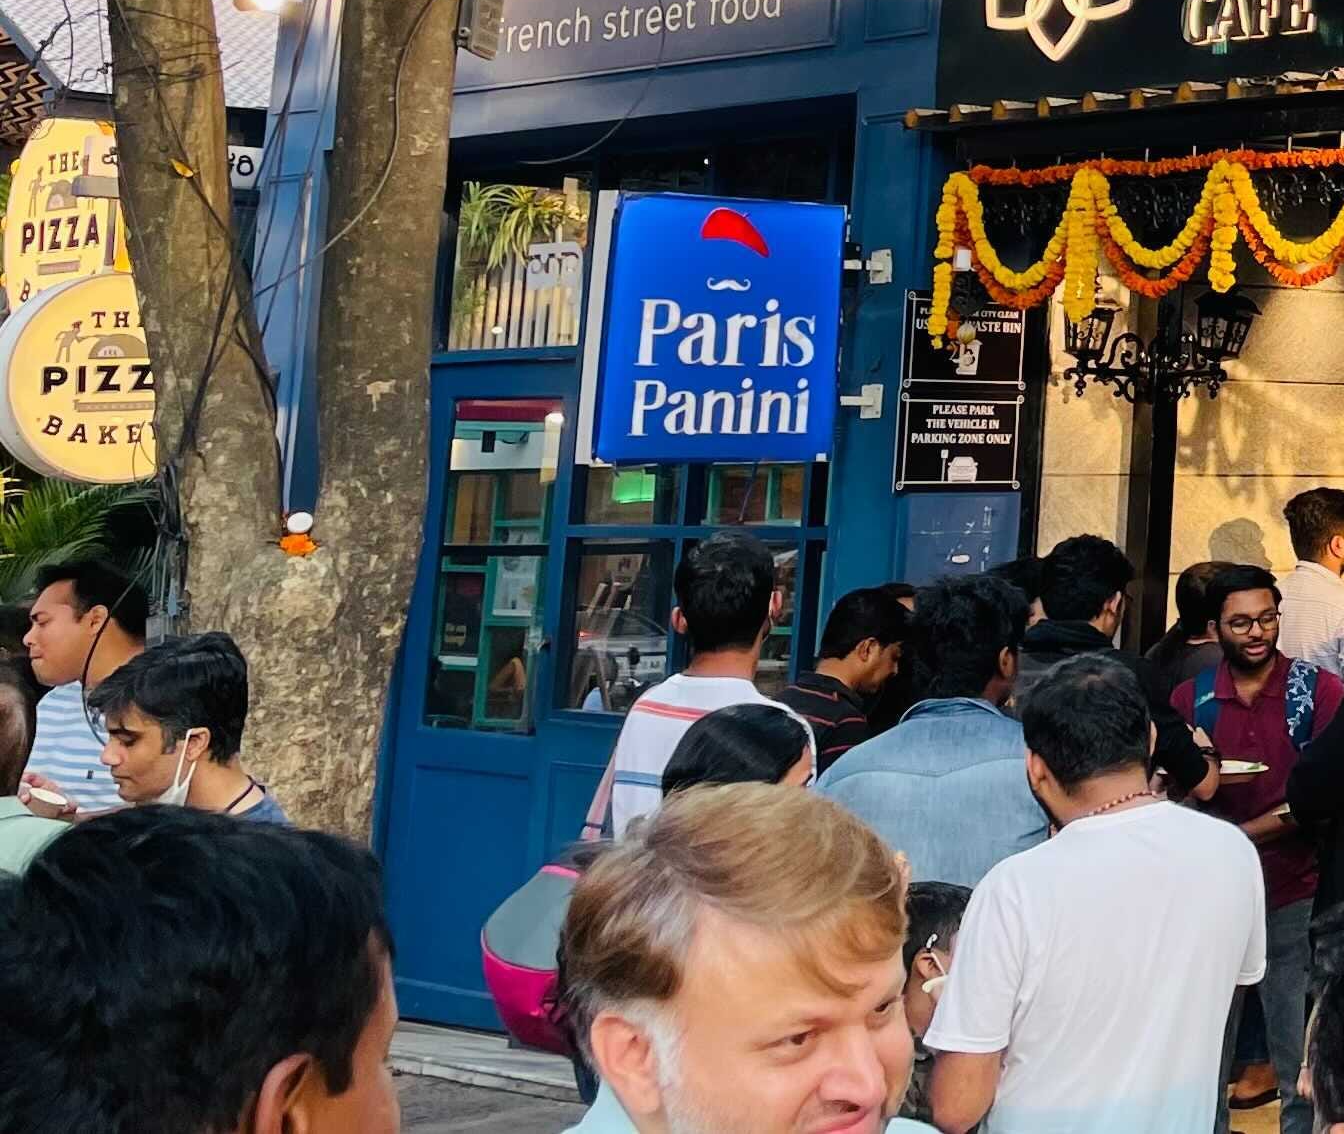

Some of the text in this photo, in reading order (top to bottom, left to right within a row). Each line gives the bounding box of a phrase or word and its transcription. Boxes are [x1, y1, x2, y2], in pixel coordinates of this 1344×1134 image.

[500, 7, 590, 53] rench
[47, 151, 79, 175] THE
[21, 213, 100, 254] PIZZA
[91, 311, 144, 328] TH
[633, 299, 816, 367] Paris
[916, 318, 929, 330] US
[1002, 322, 1022, 334] BIN
[41, 365, 155, 395] PIZZ
[626, 377, 810, 437] Panini
[932, 405, 994, 416] PLEASE PARK
[41, 415, 157, 445] BAKE
[926, 419, 1000, 429] THE VEHICLE IN
[911, 433, 1012, 445] PARKING ZONE ONLY
